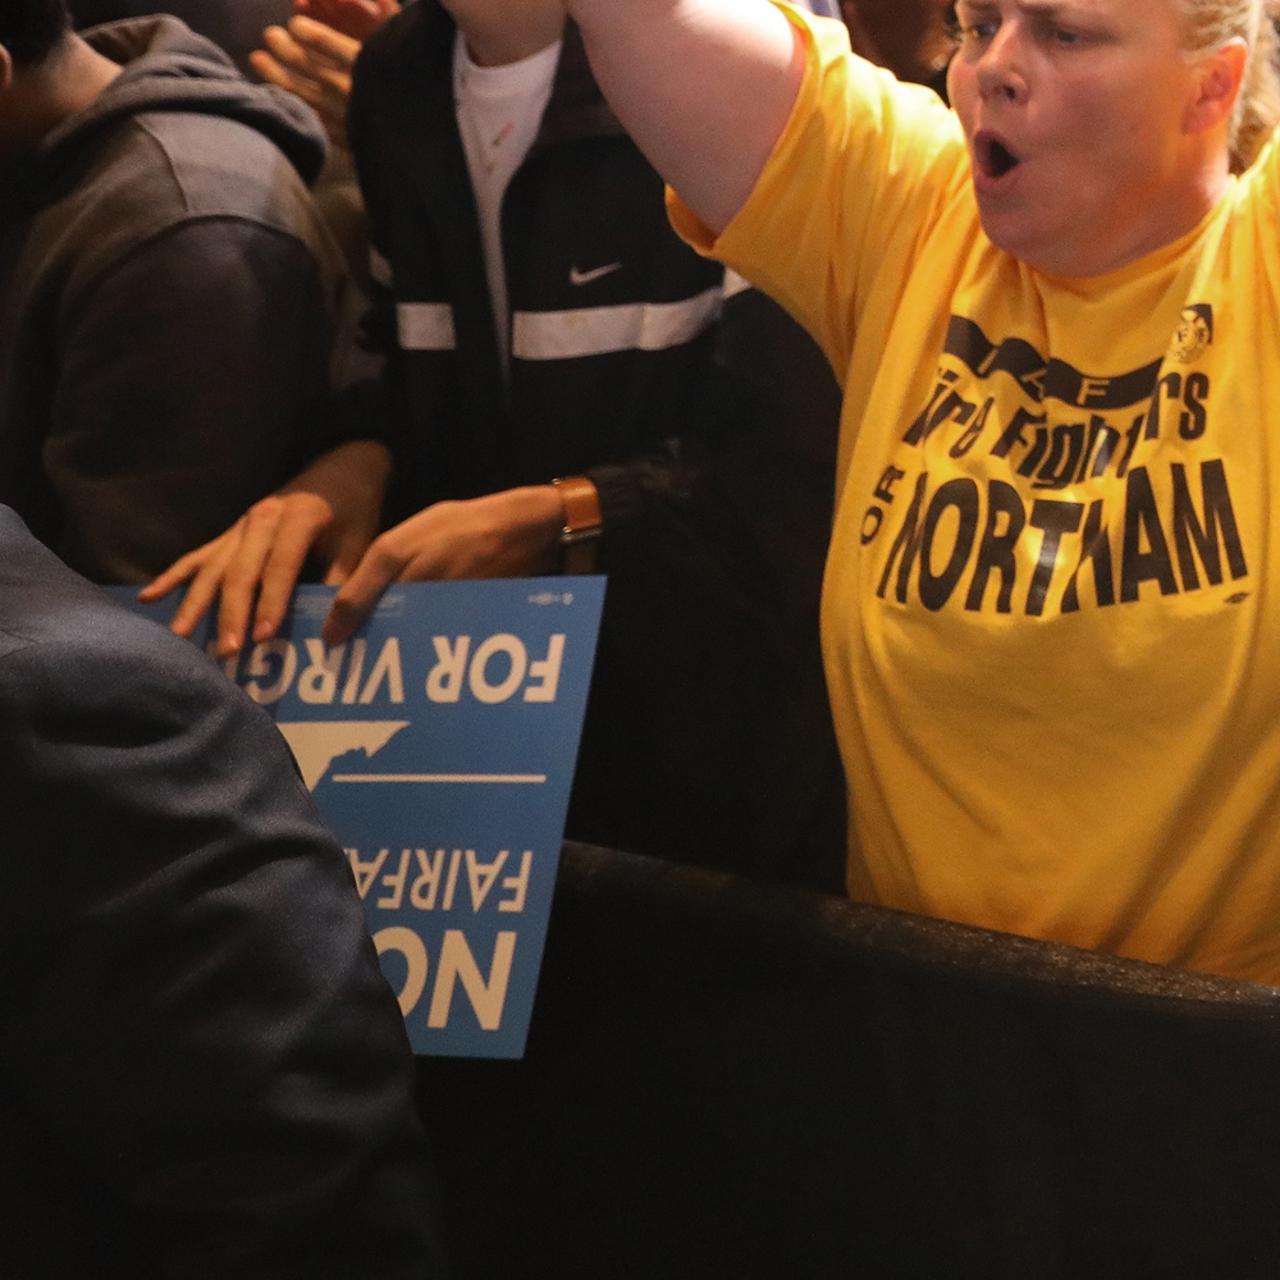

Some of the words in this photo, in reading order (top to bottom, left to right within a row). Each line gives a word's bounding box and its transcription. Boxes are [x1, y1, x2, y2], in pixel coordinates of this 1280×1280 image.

[877, 459, 1249, 617] NORTHAM
[425, 633, 566, 704] FOR
[343, 848, 534, 913] FAIRFA
